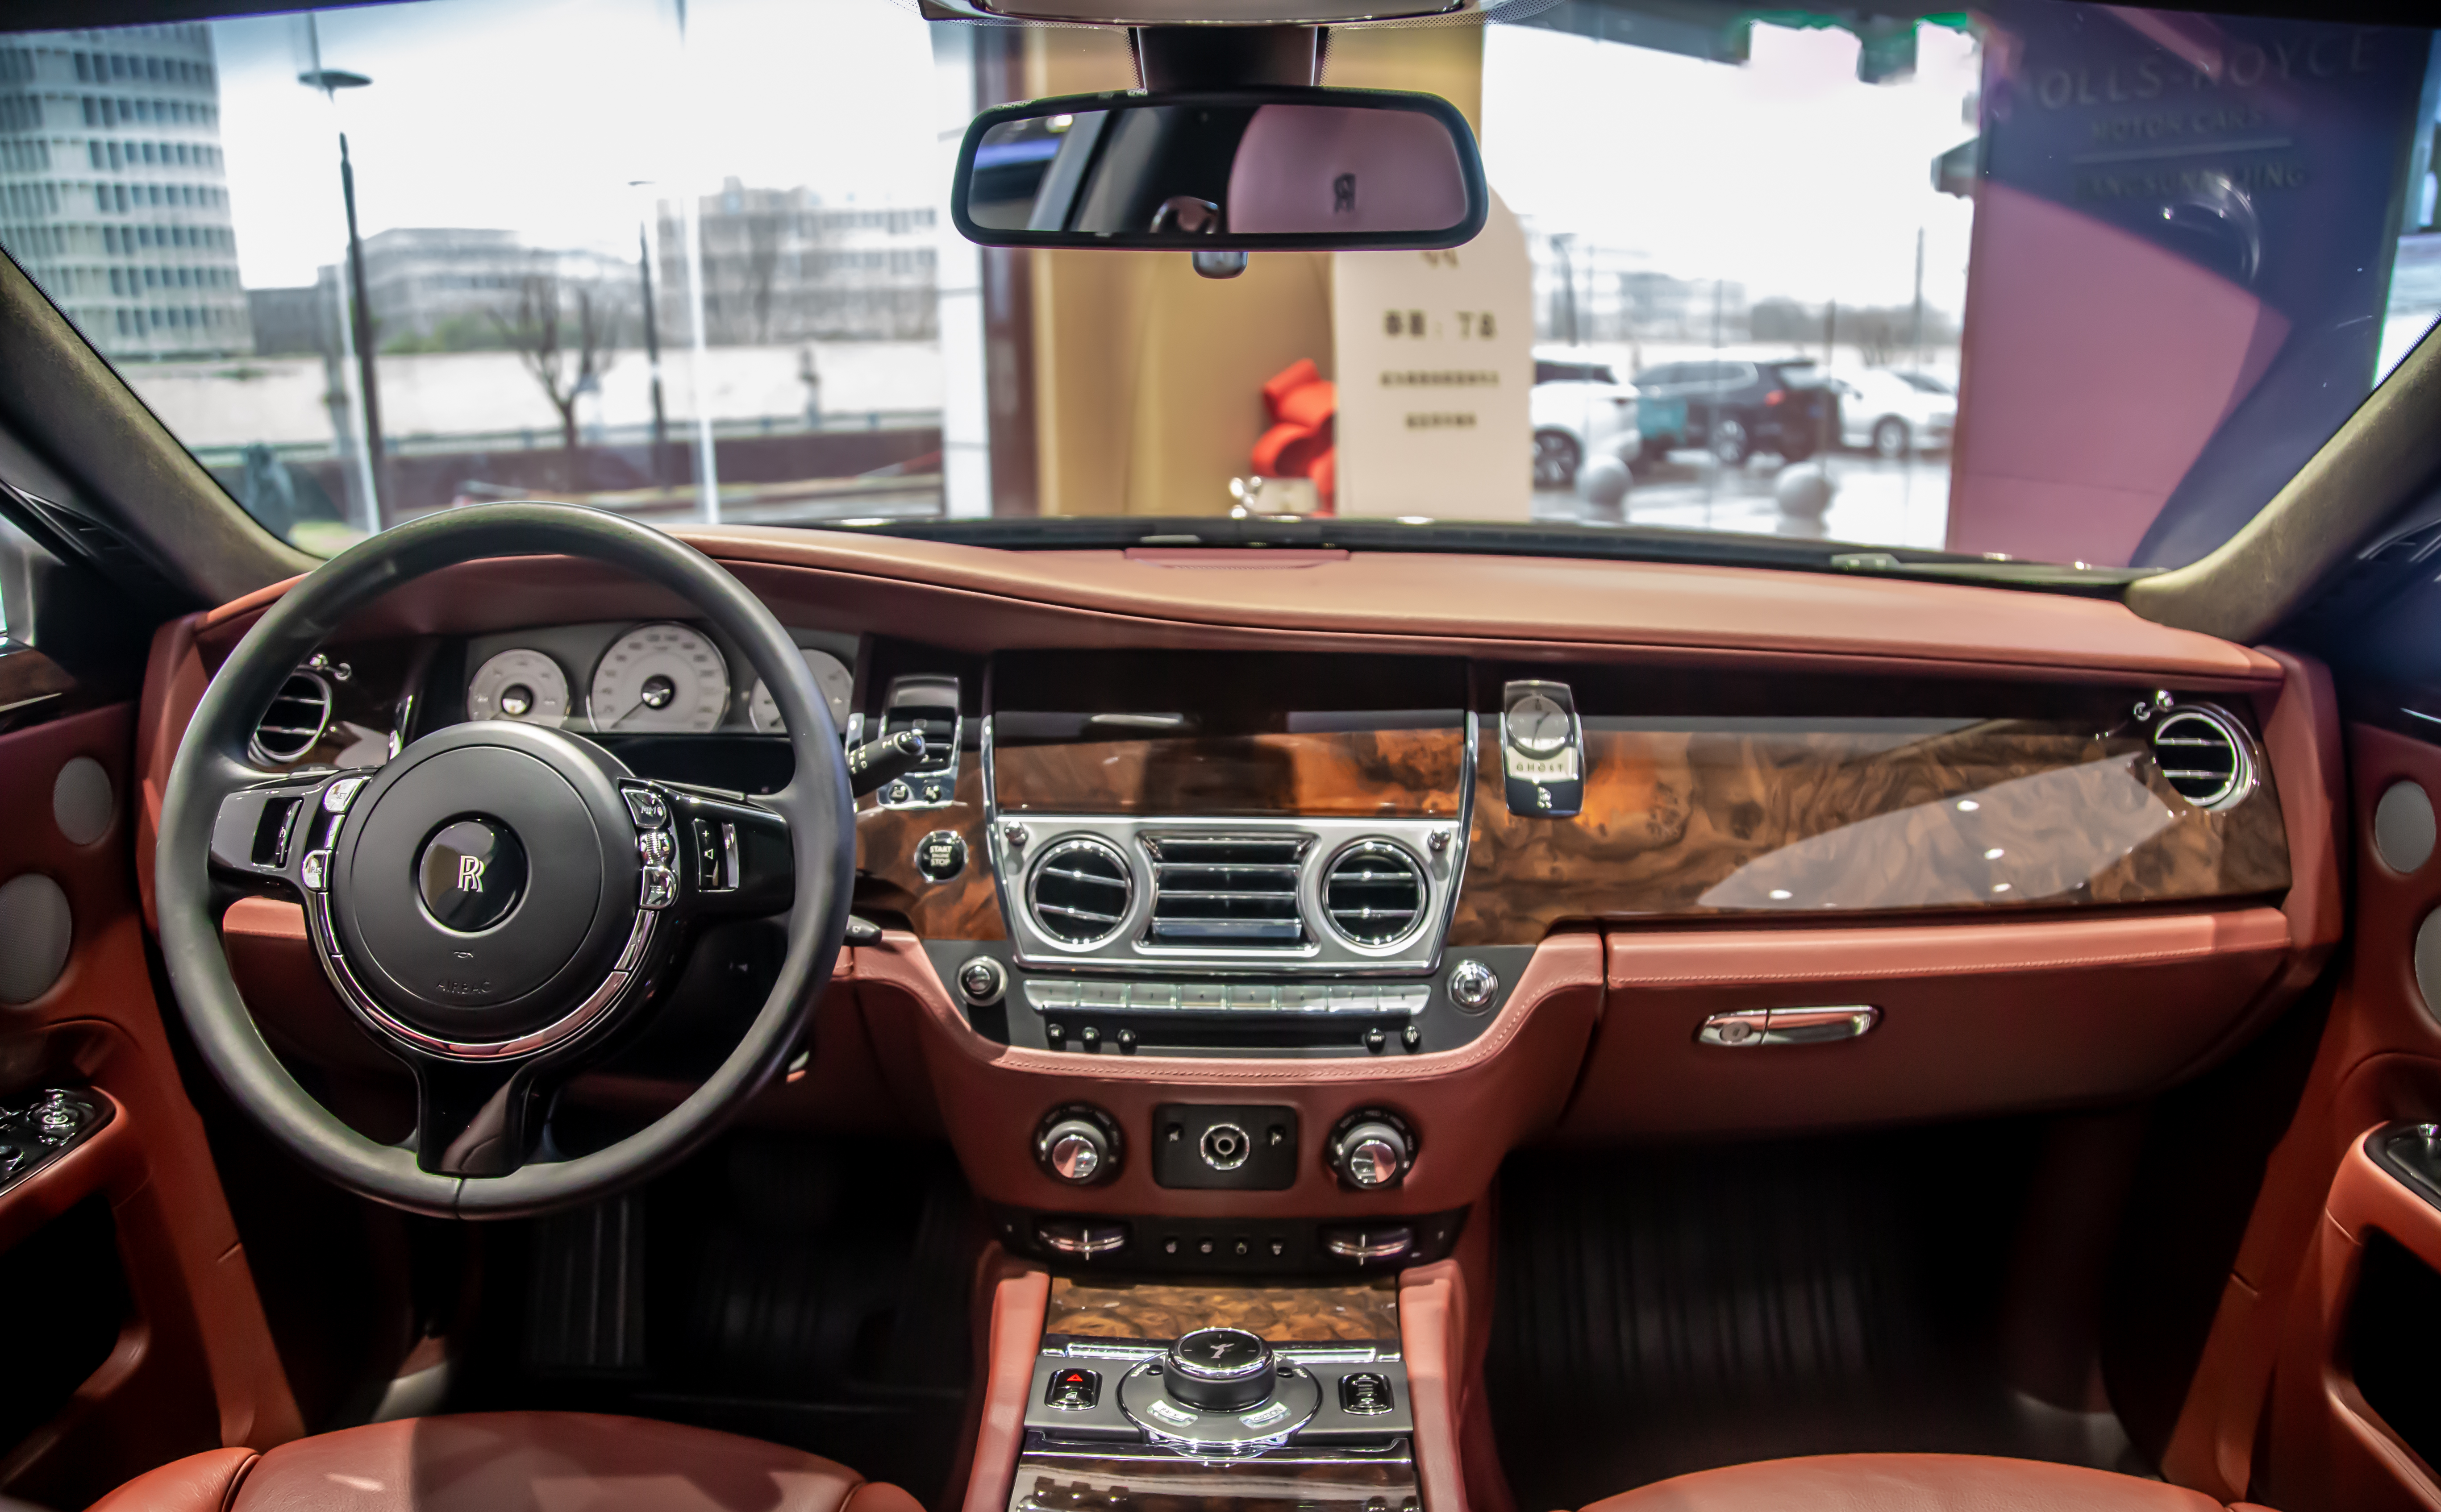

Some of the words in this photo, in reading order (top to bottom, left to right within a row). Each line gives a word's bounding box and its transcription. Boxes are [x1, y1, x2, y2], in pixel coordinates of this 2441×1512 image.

[1516, 763, 1564, 773] GHOST
[1159, 1407, 1182, 1418] BAK
[1253, 1407, 1283, 1421] OPTION
